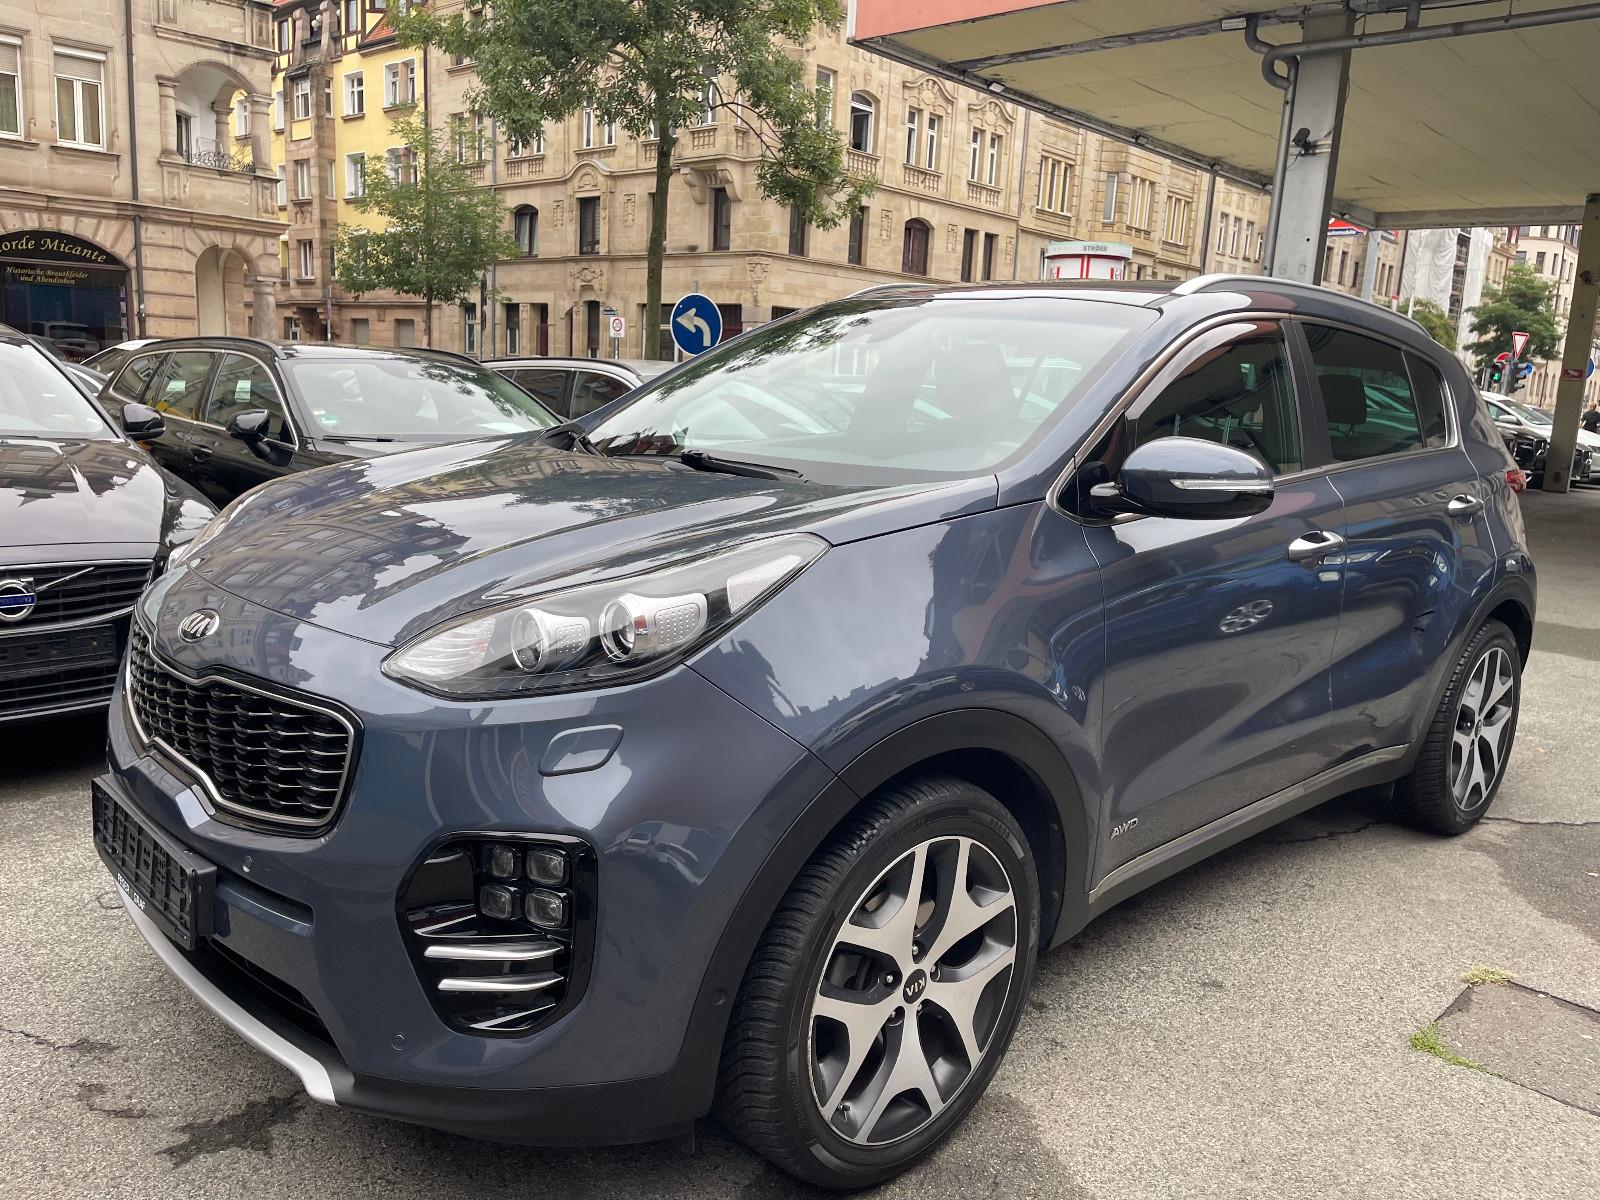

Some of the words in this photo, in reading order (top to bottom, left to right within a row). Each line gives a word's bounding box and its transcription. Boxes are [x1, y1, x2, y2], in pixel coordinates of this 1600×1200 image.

[0, 235, 35, 252] orde
[41, 238, 107, 263] Micante
[1110, 817, 1139, 840] AWD
[905, 976, 926, 997] KIA
